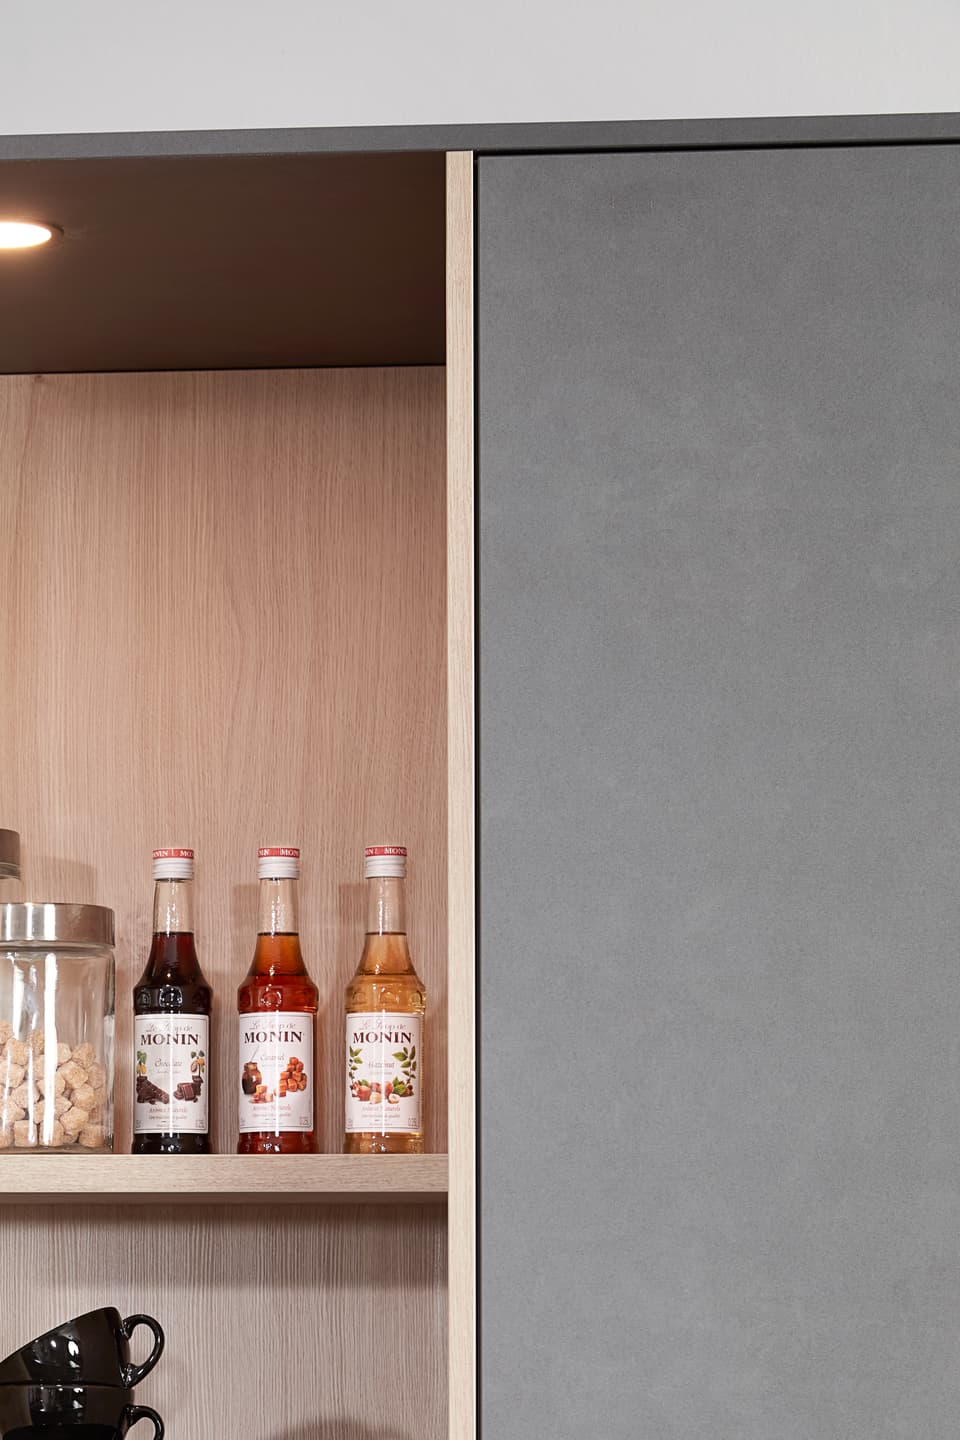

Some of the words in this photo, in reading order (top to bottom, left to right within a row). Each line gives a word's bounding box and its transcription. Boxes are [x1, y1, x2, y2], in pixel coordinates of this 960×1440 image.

[141, 1034, 198, 1045] MONIN
[244, 1031, 302, 1043] MONIN
[353, 1032, 411, 1043] MONIN
